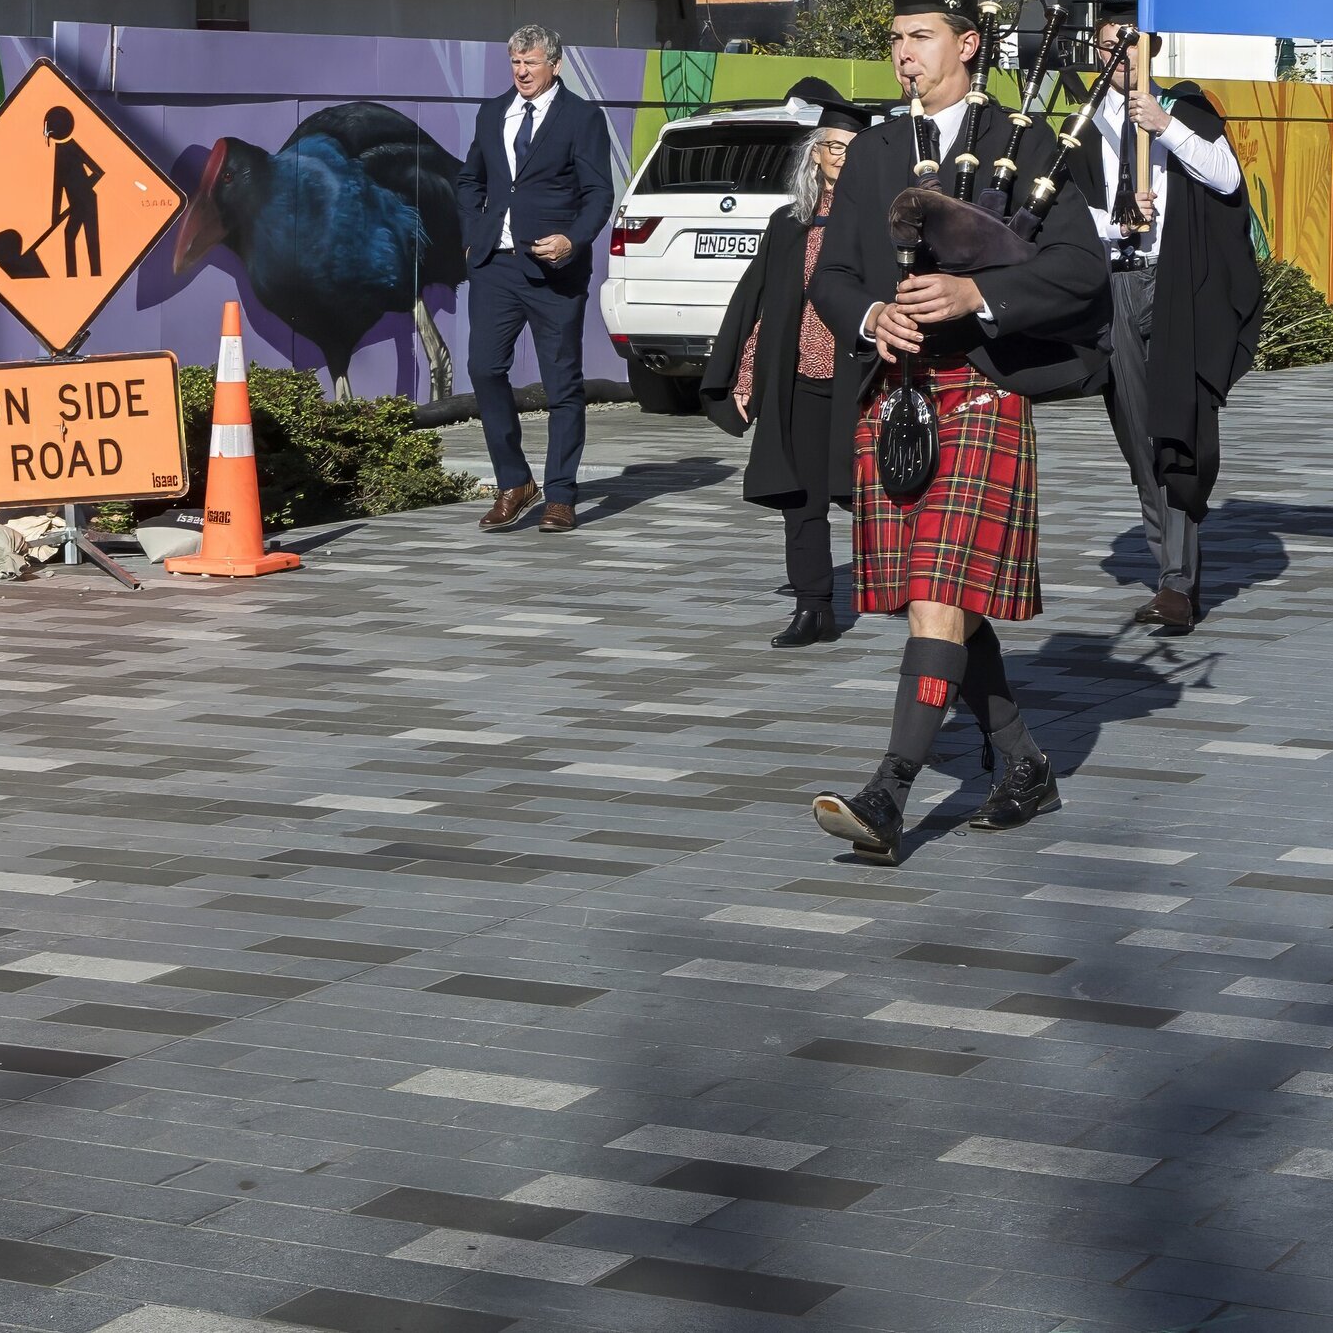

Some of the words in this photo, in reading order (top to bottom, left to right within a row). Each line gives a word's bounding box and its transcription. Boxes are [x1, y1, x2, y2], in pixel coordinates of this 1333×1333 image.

[698, 235, 757, 254] HND963
[58, 379, 149, 422] SIDE
[11, 438, 123, 482] ROAD
